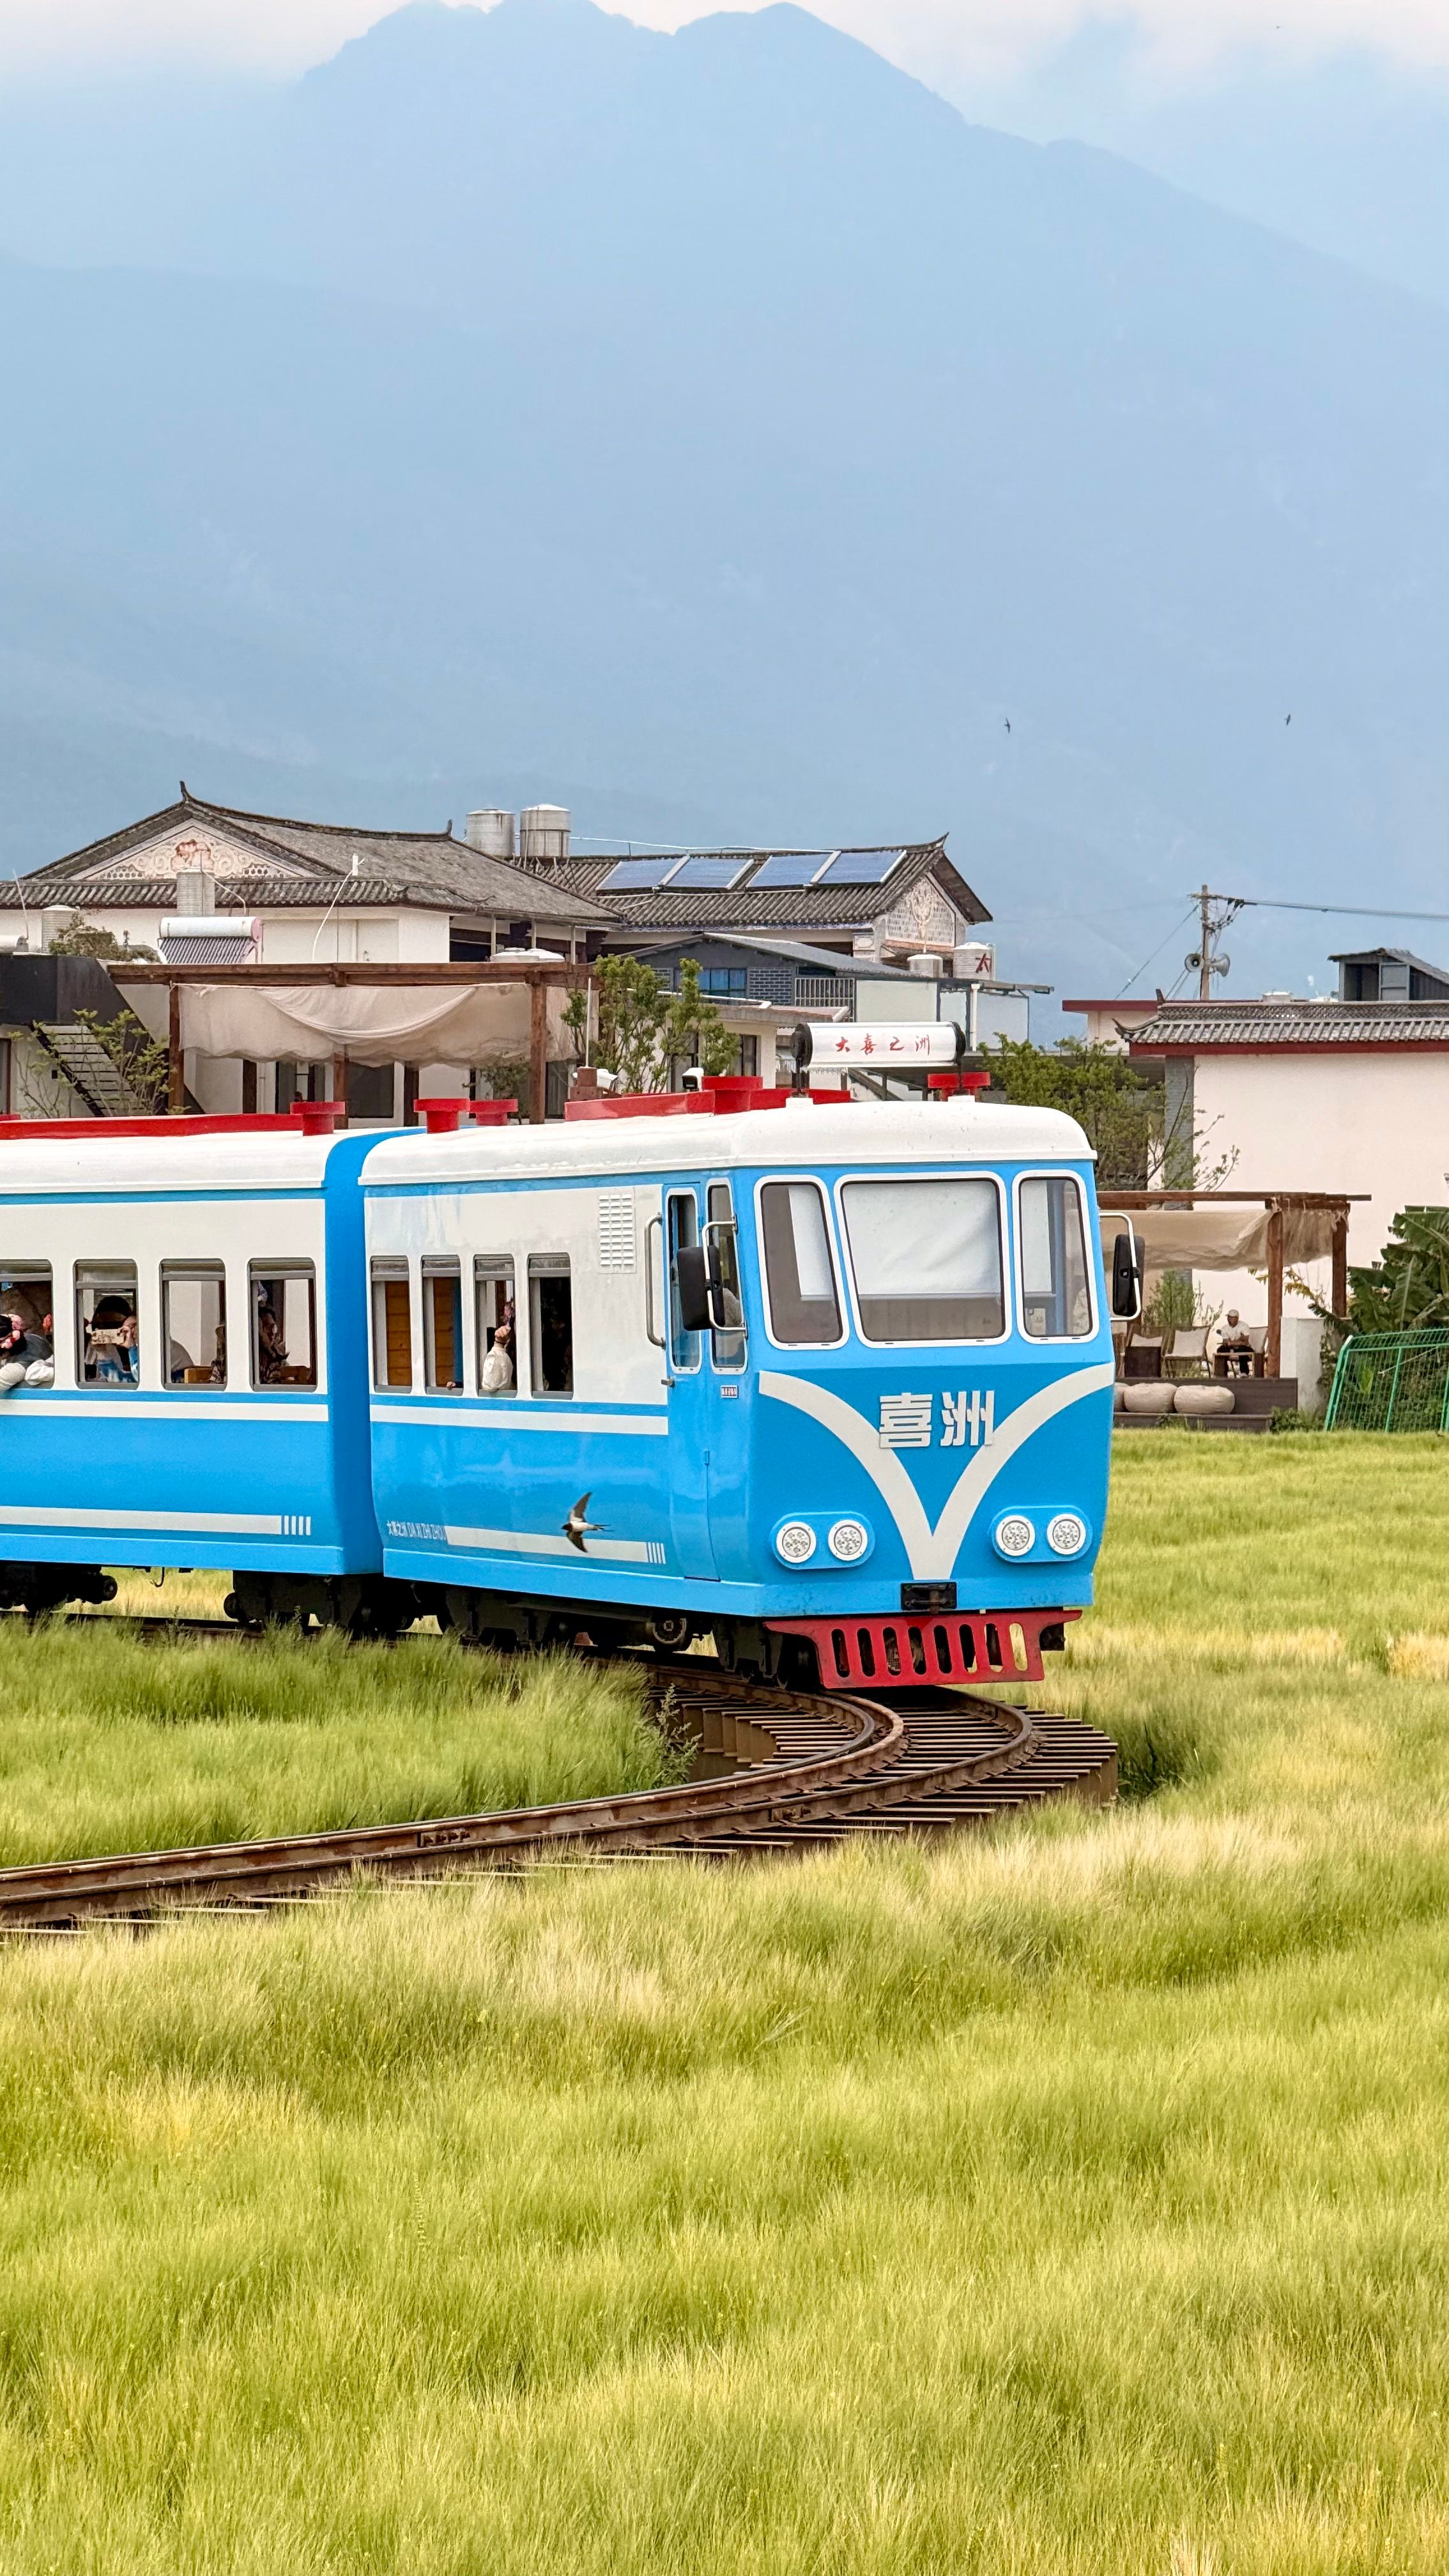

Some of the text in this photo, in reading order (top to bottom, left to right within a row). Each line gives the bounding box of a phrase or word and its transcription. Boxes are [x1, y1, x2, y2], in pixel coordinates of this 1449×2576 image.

[835, 1033, 930, 1055] 大喜之洲
[879, 1390, 995, 1449] 喜洲
